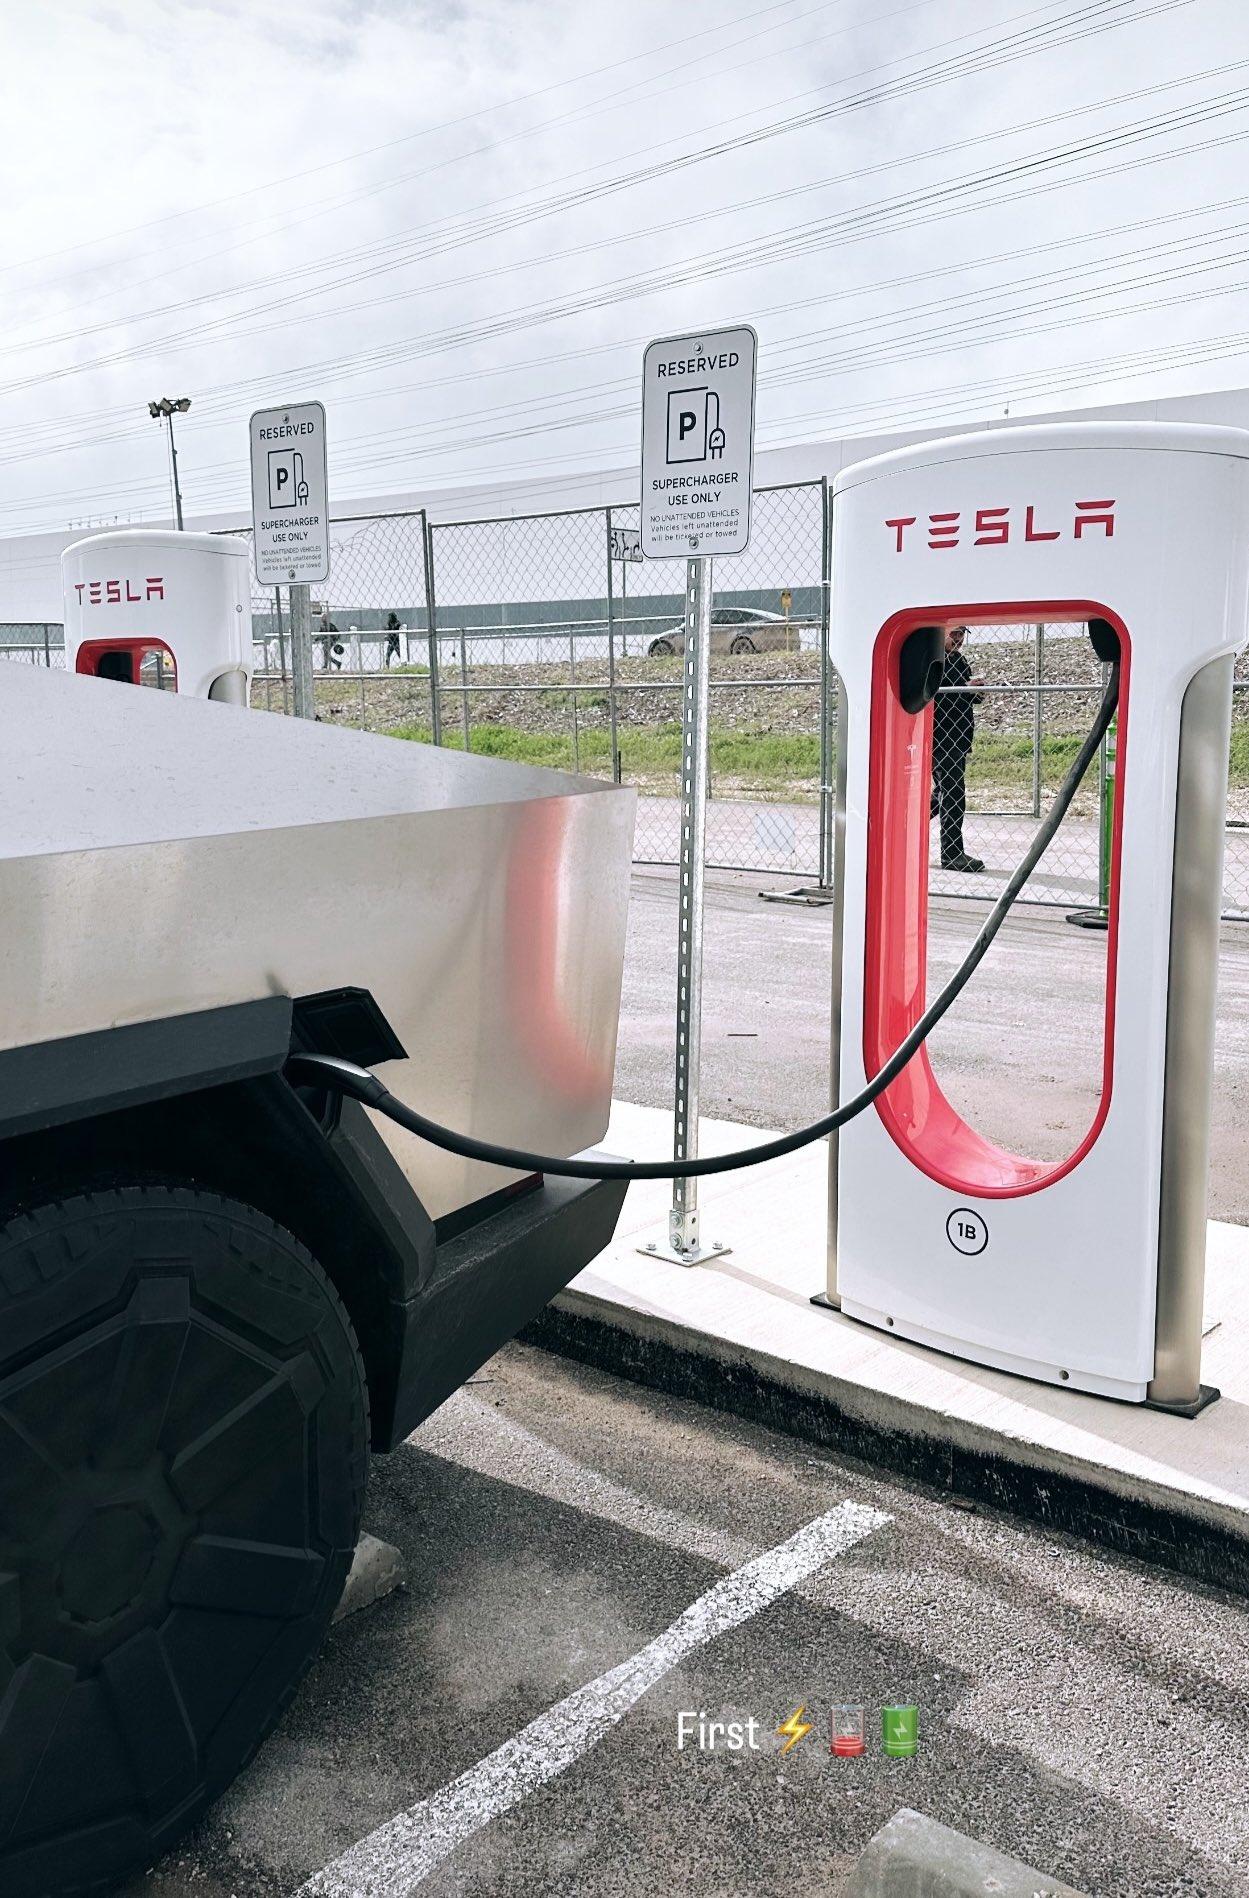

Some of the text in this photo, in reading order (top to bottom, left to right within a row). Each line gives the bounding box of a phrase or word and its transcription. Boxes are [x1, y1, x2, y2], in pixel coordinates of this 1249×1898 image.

[657, 352, 740, 378] RESERVED
[259, 421, 315, 440] RESERVED
[679, 411, 697, 441] P
[276, 467, 289, 491] P
[652, 472, 739, 491] SUPERCHARGER
[668, 491, 721, 506] USE ONLY
[261, 516, 319, 530] SUPERCHARGER
[651, 508, 740, 523] NO UNATTENDED VEHICLES
[651, 519, 738, 532] Vehicles left unattended
[885, 499, 1117, 553] TESLA
[272, 531, 309, 543] USE ONLY
[664, 533, 673, 541] be
[715, 529, 738, 538] towed
[74, 577, 164, 606] TESLA
[957, 1222, 977, 1240] 1B
